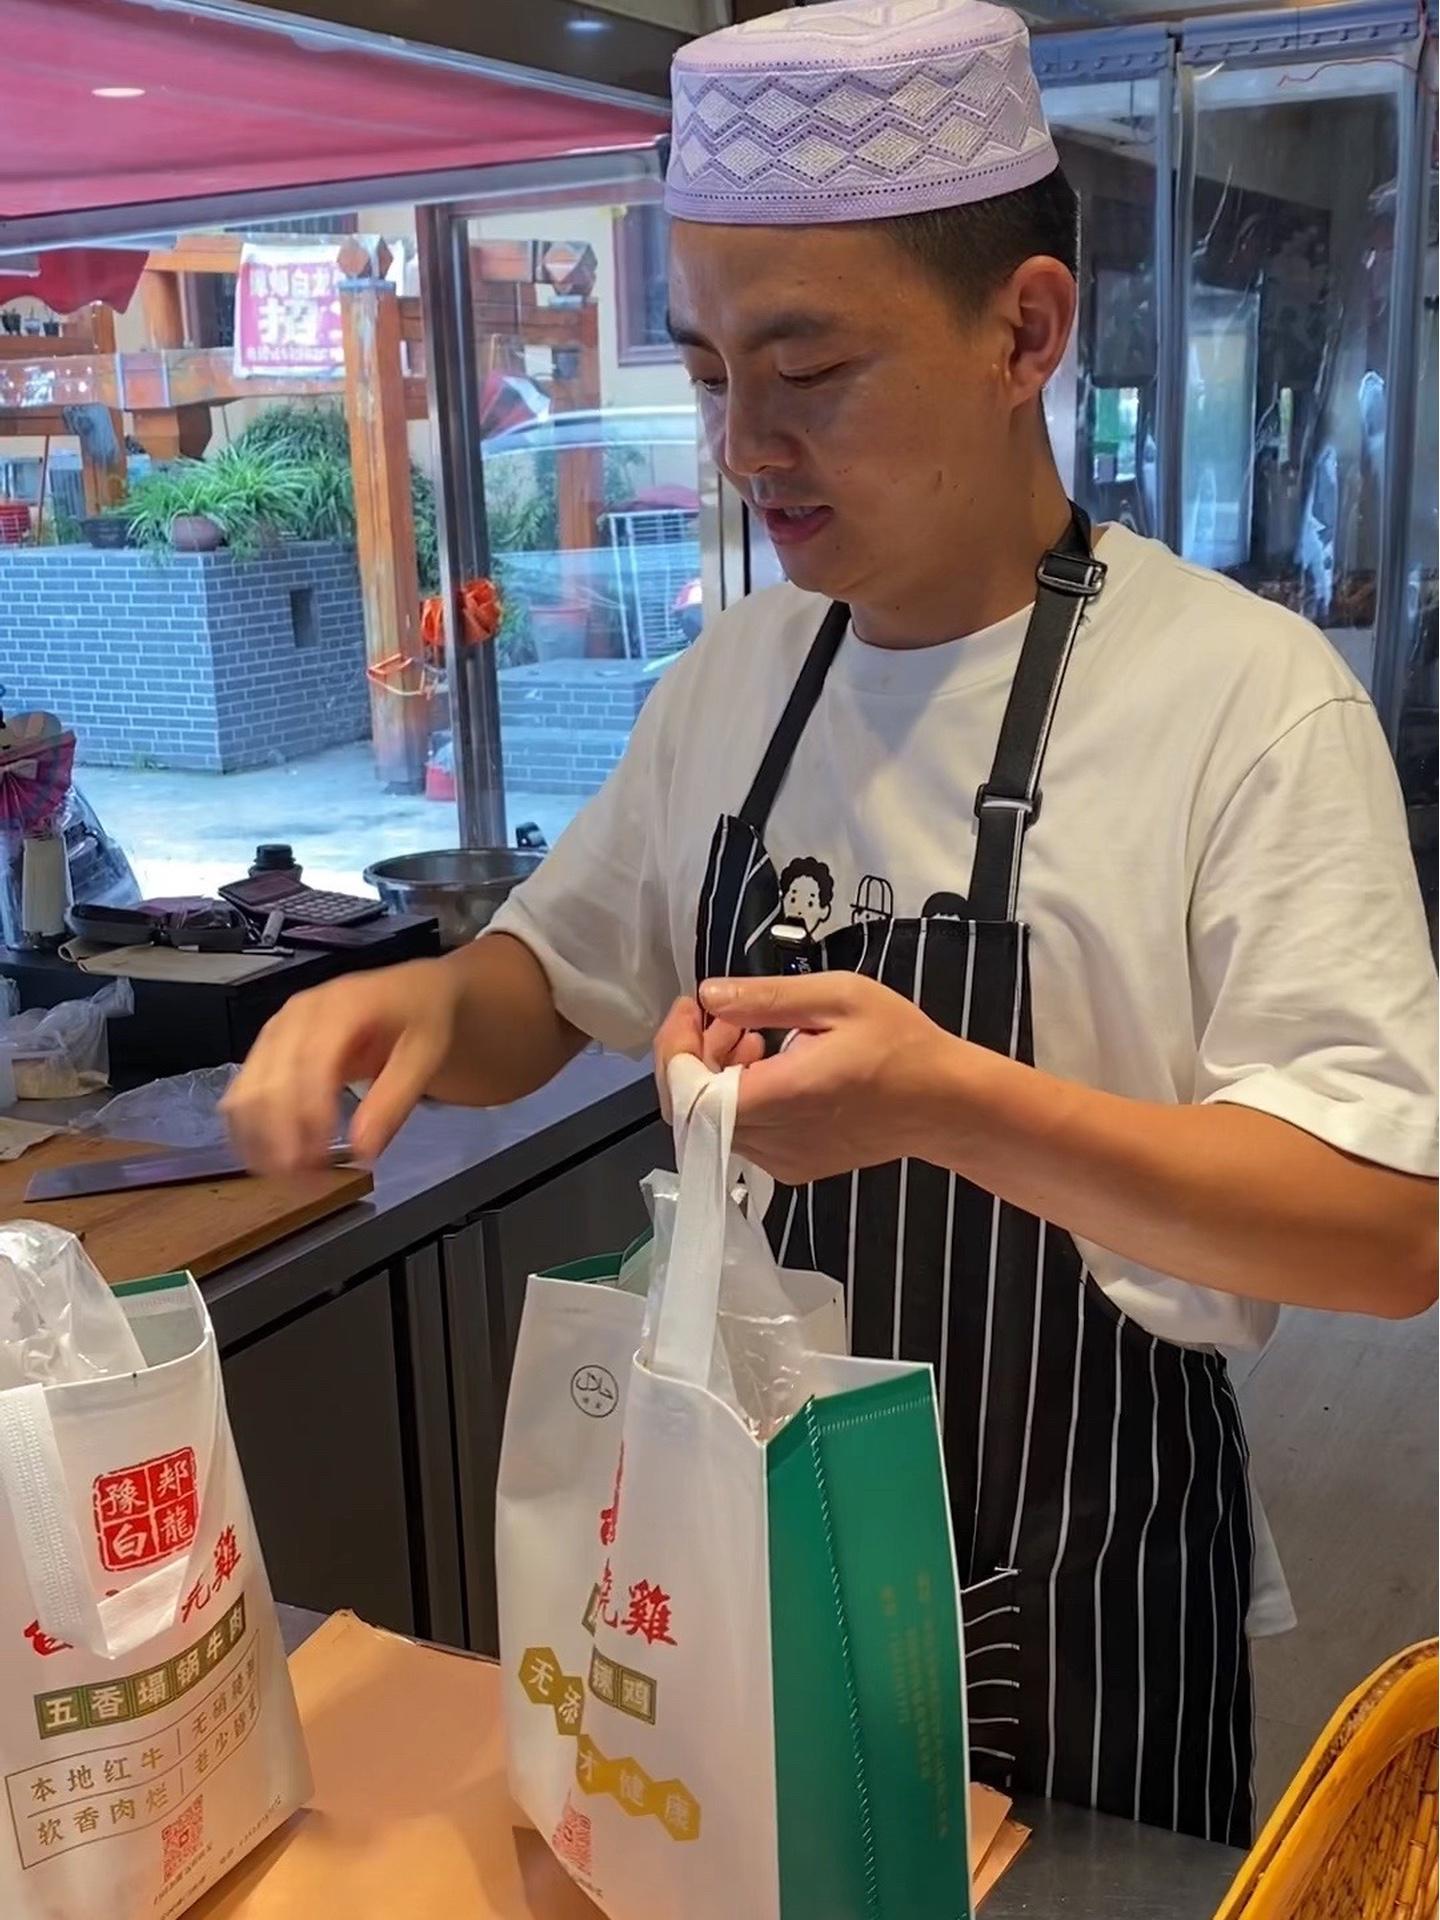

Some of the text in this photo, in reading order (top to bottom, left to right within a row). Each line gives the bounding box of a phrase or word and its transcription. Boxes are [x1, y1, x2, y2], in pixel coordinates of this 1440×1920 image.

[30, 1746, 165, 1803] 本地红牛
[36, 1782, 169, 1847] 软香肉烂
